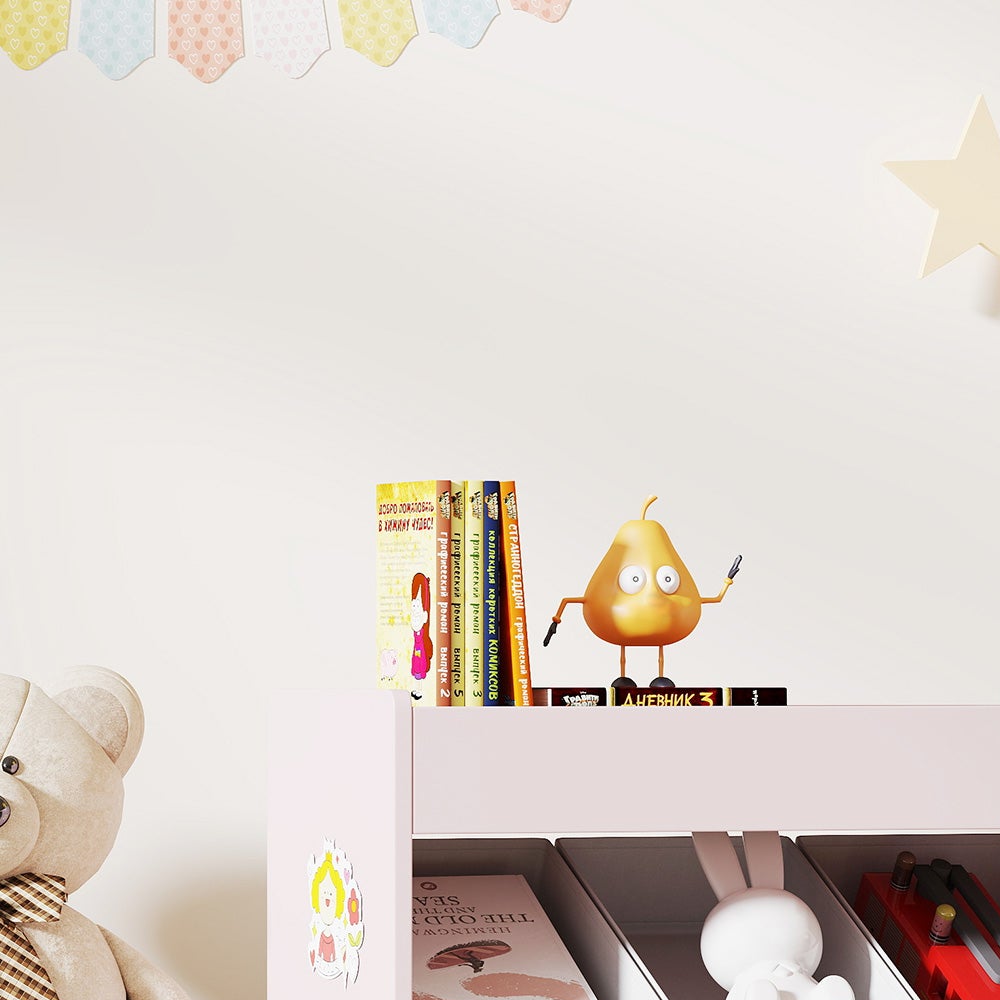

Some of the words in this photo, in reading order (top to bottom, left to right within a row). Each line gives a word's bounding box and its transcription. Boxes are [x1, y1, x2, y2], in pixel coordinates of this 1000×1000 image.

[486, 530, 496, 584] коллекция
[508, 524, 524, 609] СТРАННОГЕДДОН
[437, 602, 448, 634] роман
[452, 603, 461, 634] роман
[470, 603, 480, 634] роман
[485, 588, 496, 635] коротких
[437, 647, 448, 684] выпуск
[452, 648, 461, 684] выпуск
[470, 648, 480, 684] выпуск
[488, 639, 499, 700] КОМИКСОВ
[440, 689, 450, 698] 2
[454, 690, 464, 698] 5
[472, 690, 482, 698] 3
[620, 692, 695, 706] ДНЕВНИК
[699, 691, 714, 706] 3
[412, 896, 460, 906] SEA
[443, 906, 476, 914] AND
[425, 914, 476, 926] OLD
[481, 913, 534, 924] THE
